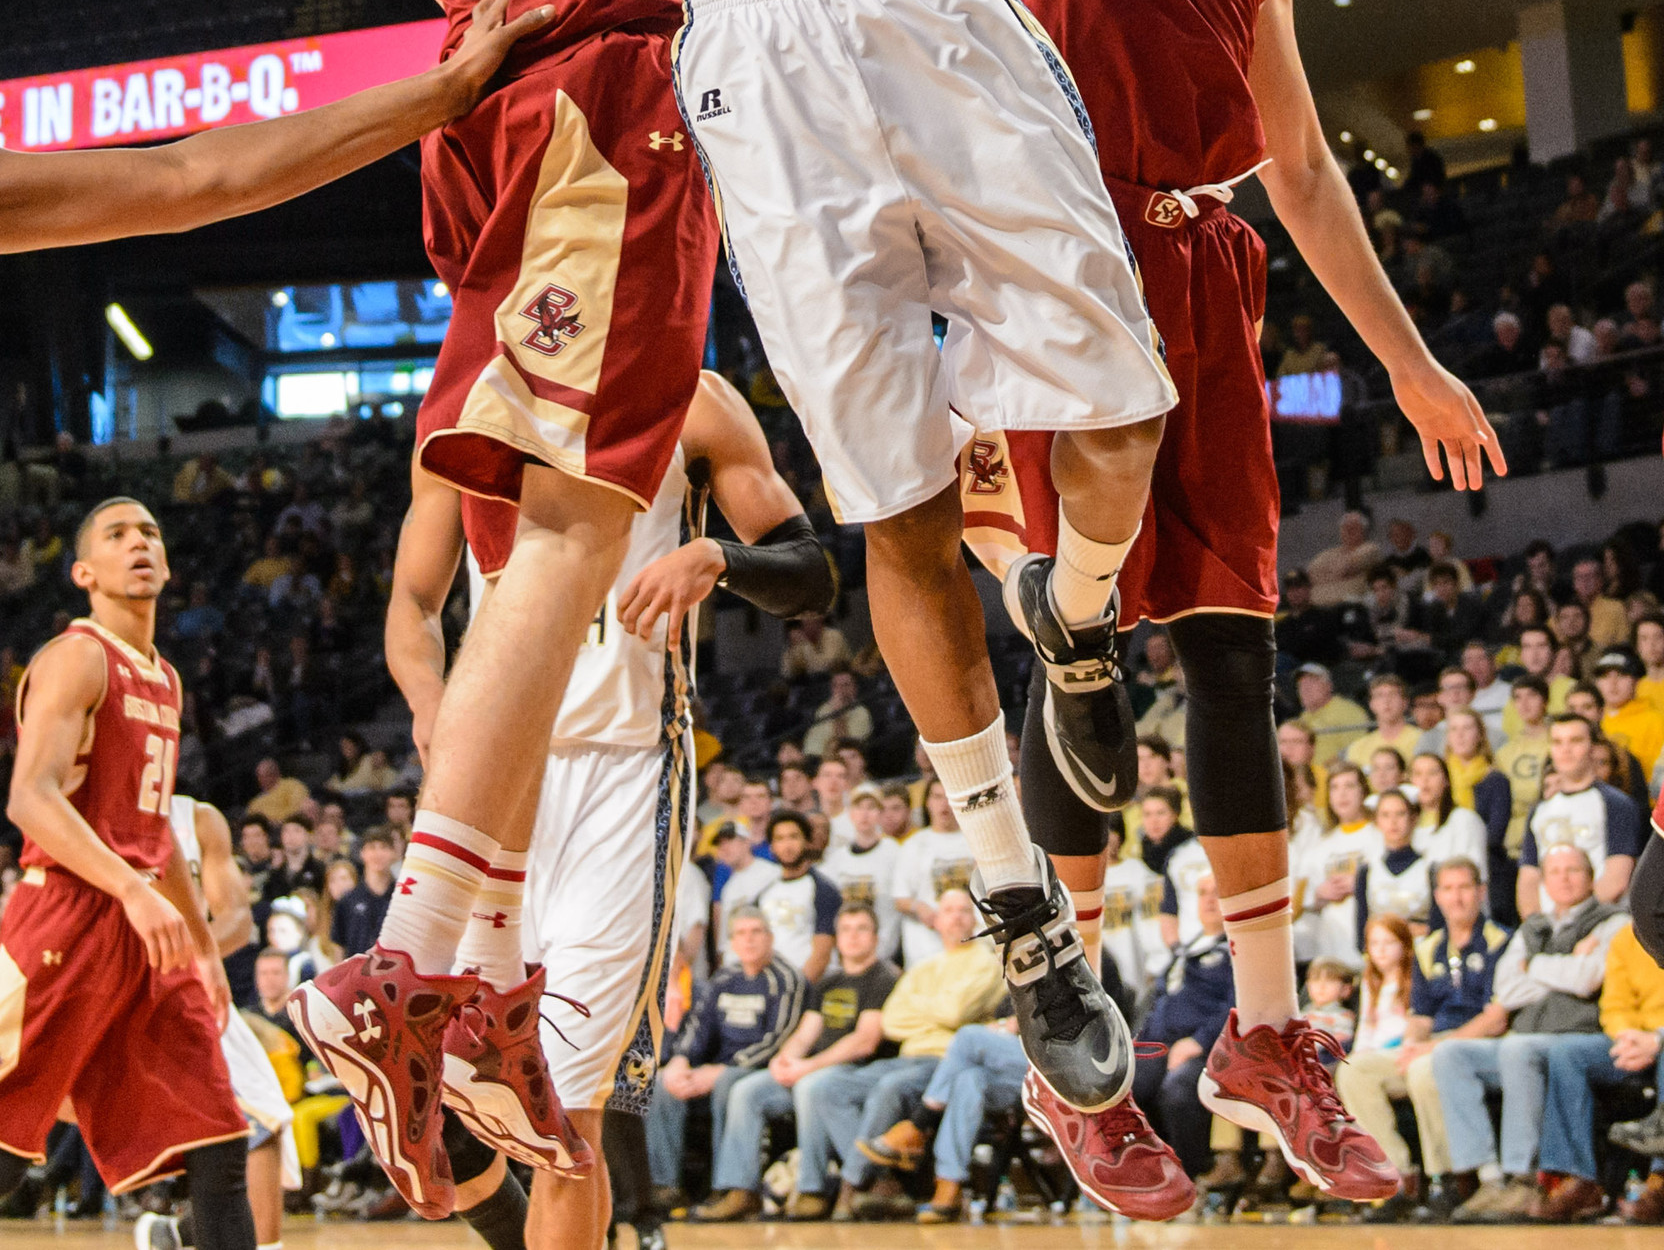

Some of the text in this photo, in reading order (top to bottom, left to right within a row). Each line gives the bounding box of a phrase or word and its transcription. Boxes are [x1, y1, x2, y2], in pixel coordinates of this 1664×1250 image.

[22, 82, 73, 146] IN
[696, 106, 732, 122] RUSSELL
[700, 88, 721, 112] R
[138, 733, 175, 817] 21
